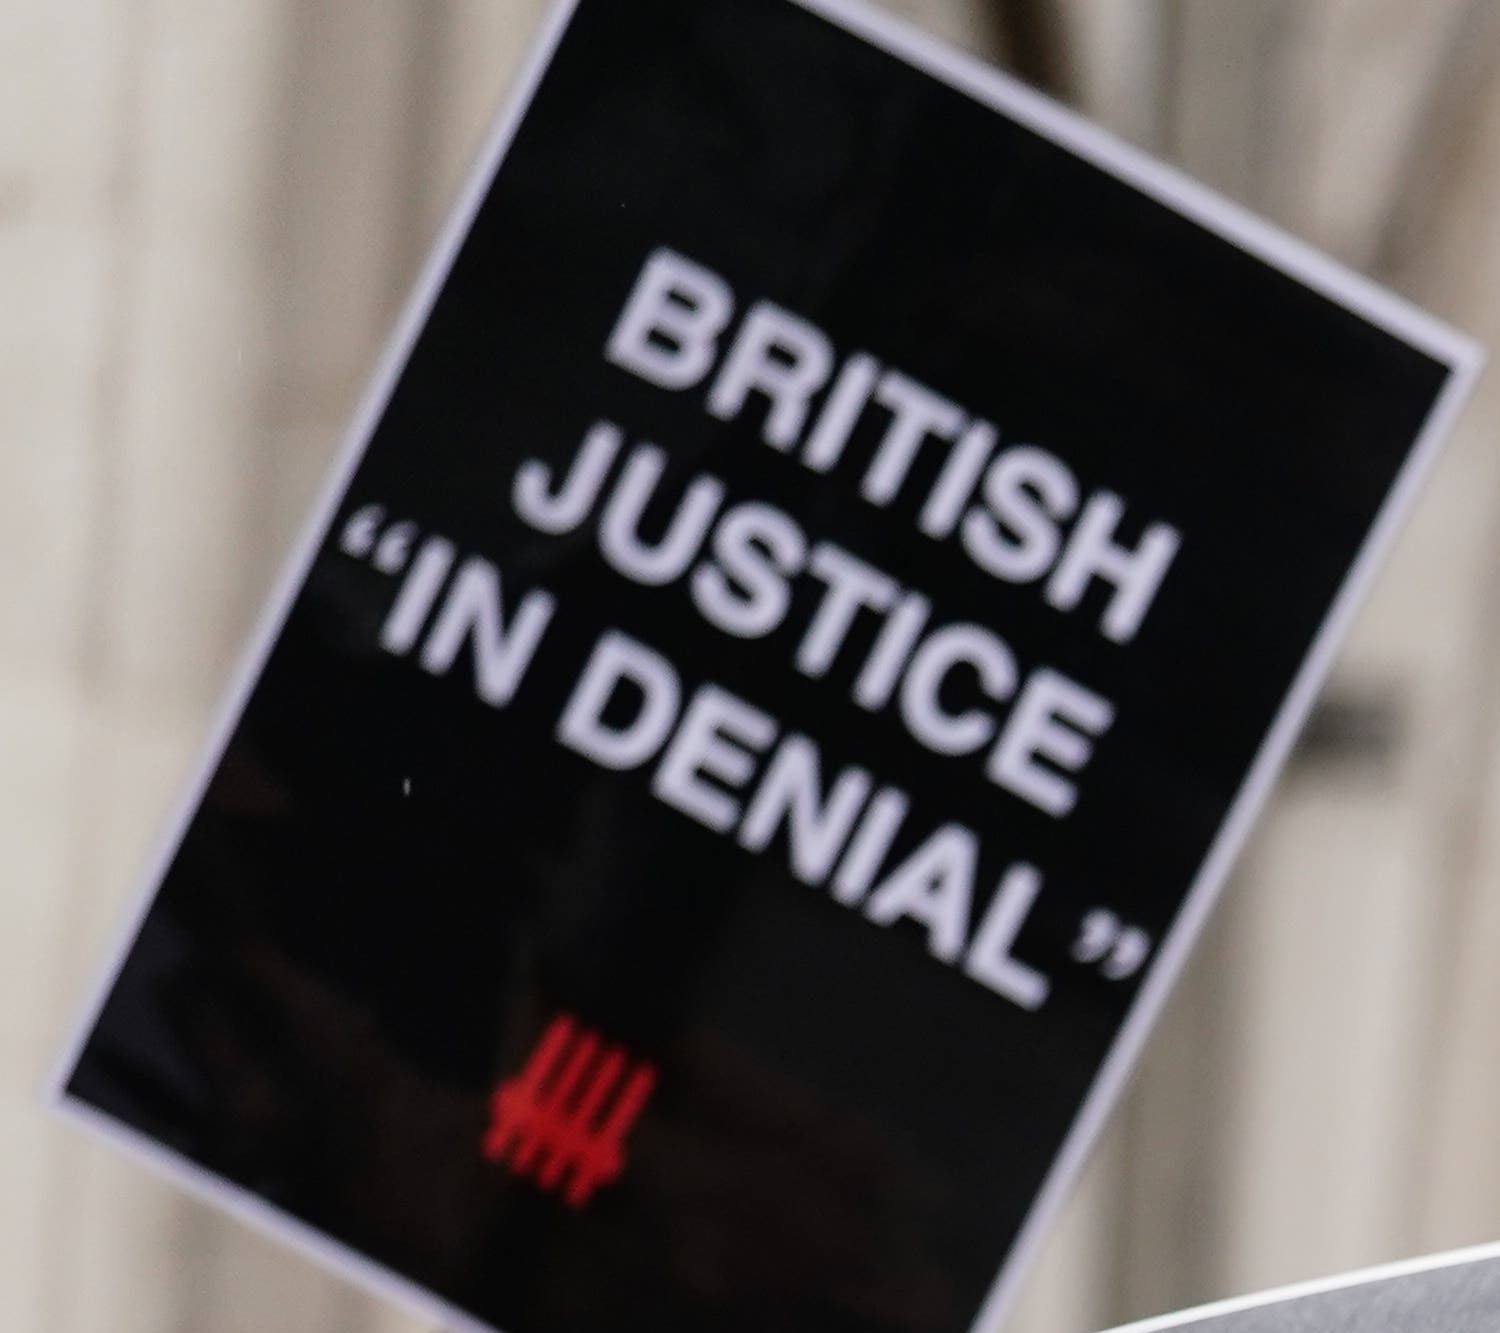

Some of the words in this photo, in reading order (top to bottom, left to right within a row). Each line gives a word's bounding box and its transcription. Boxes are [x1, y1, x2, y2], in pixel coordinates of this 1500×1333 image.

[514, 425, 1112, 814] JUSTICE
[607, 250, 1178, 641] BRITISH
[339, 503, 552, 704] “IN
[558, 634, 1145, 1006] DENIAL”
